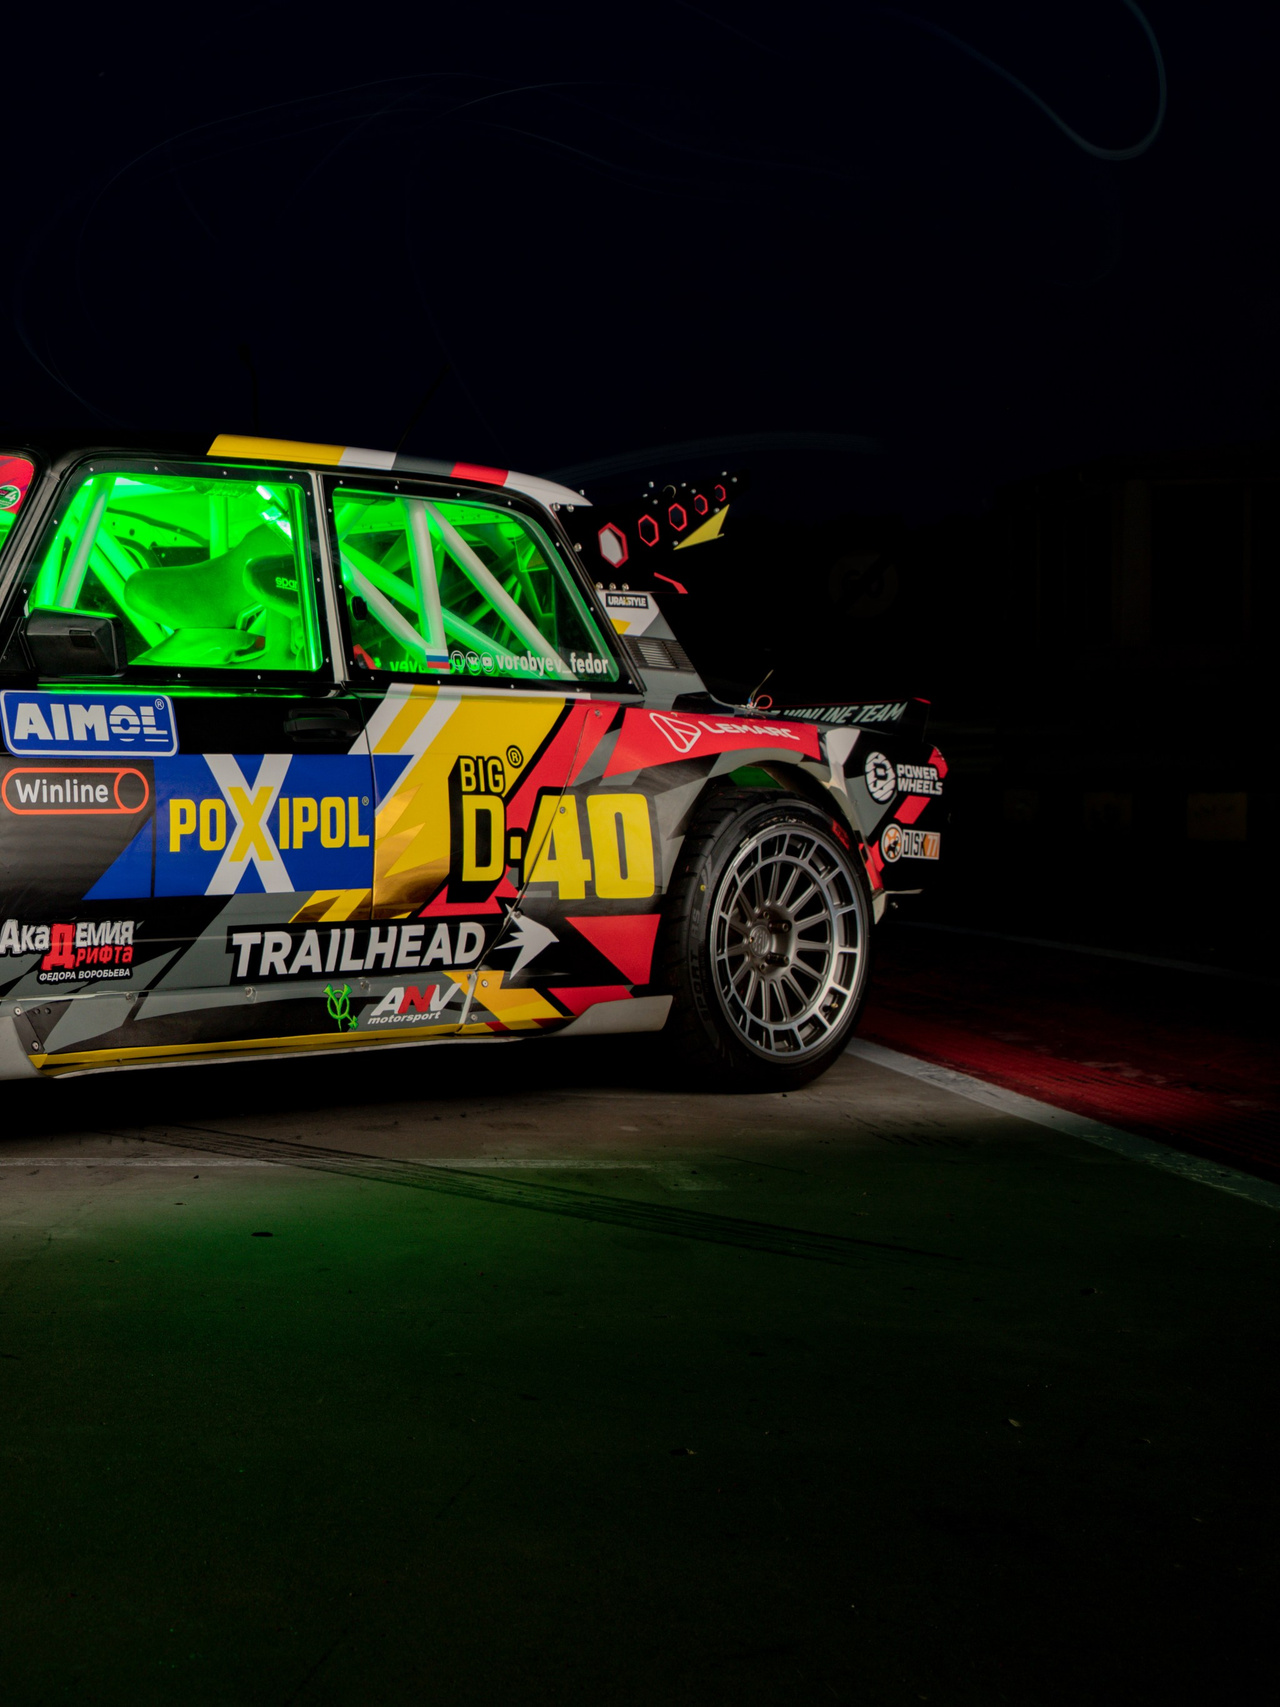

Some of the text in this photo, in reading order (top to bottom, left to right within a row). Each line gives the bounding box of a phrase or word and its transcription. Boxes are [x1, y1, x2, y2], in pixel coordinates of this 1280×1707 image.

[496, 650, 609, 676] vorobyev_fedor
[852, 701, 908, 723] TEAM
[698, 720, 800, 741] LEMARC
[461, 756, 505, 794] BIG
[896, 764, 939, 781] POWER
[15, 778, 109, 803] Winline
[898, 778, 943, 795] WHEELS
[232, 922, 486, 977] TRAILHEAD
[39, 968, 131, 982] ФЕДОРА ВОРОБЬЕВА
[371, 983, 462, 1016] ANV
[368, 1011, 441, 1025] motorsport
